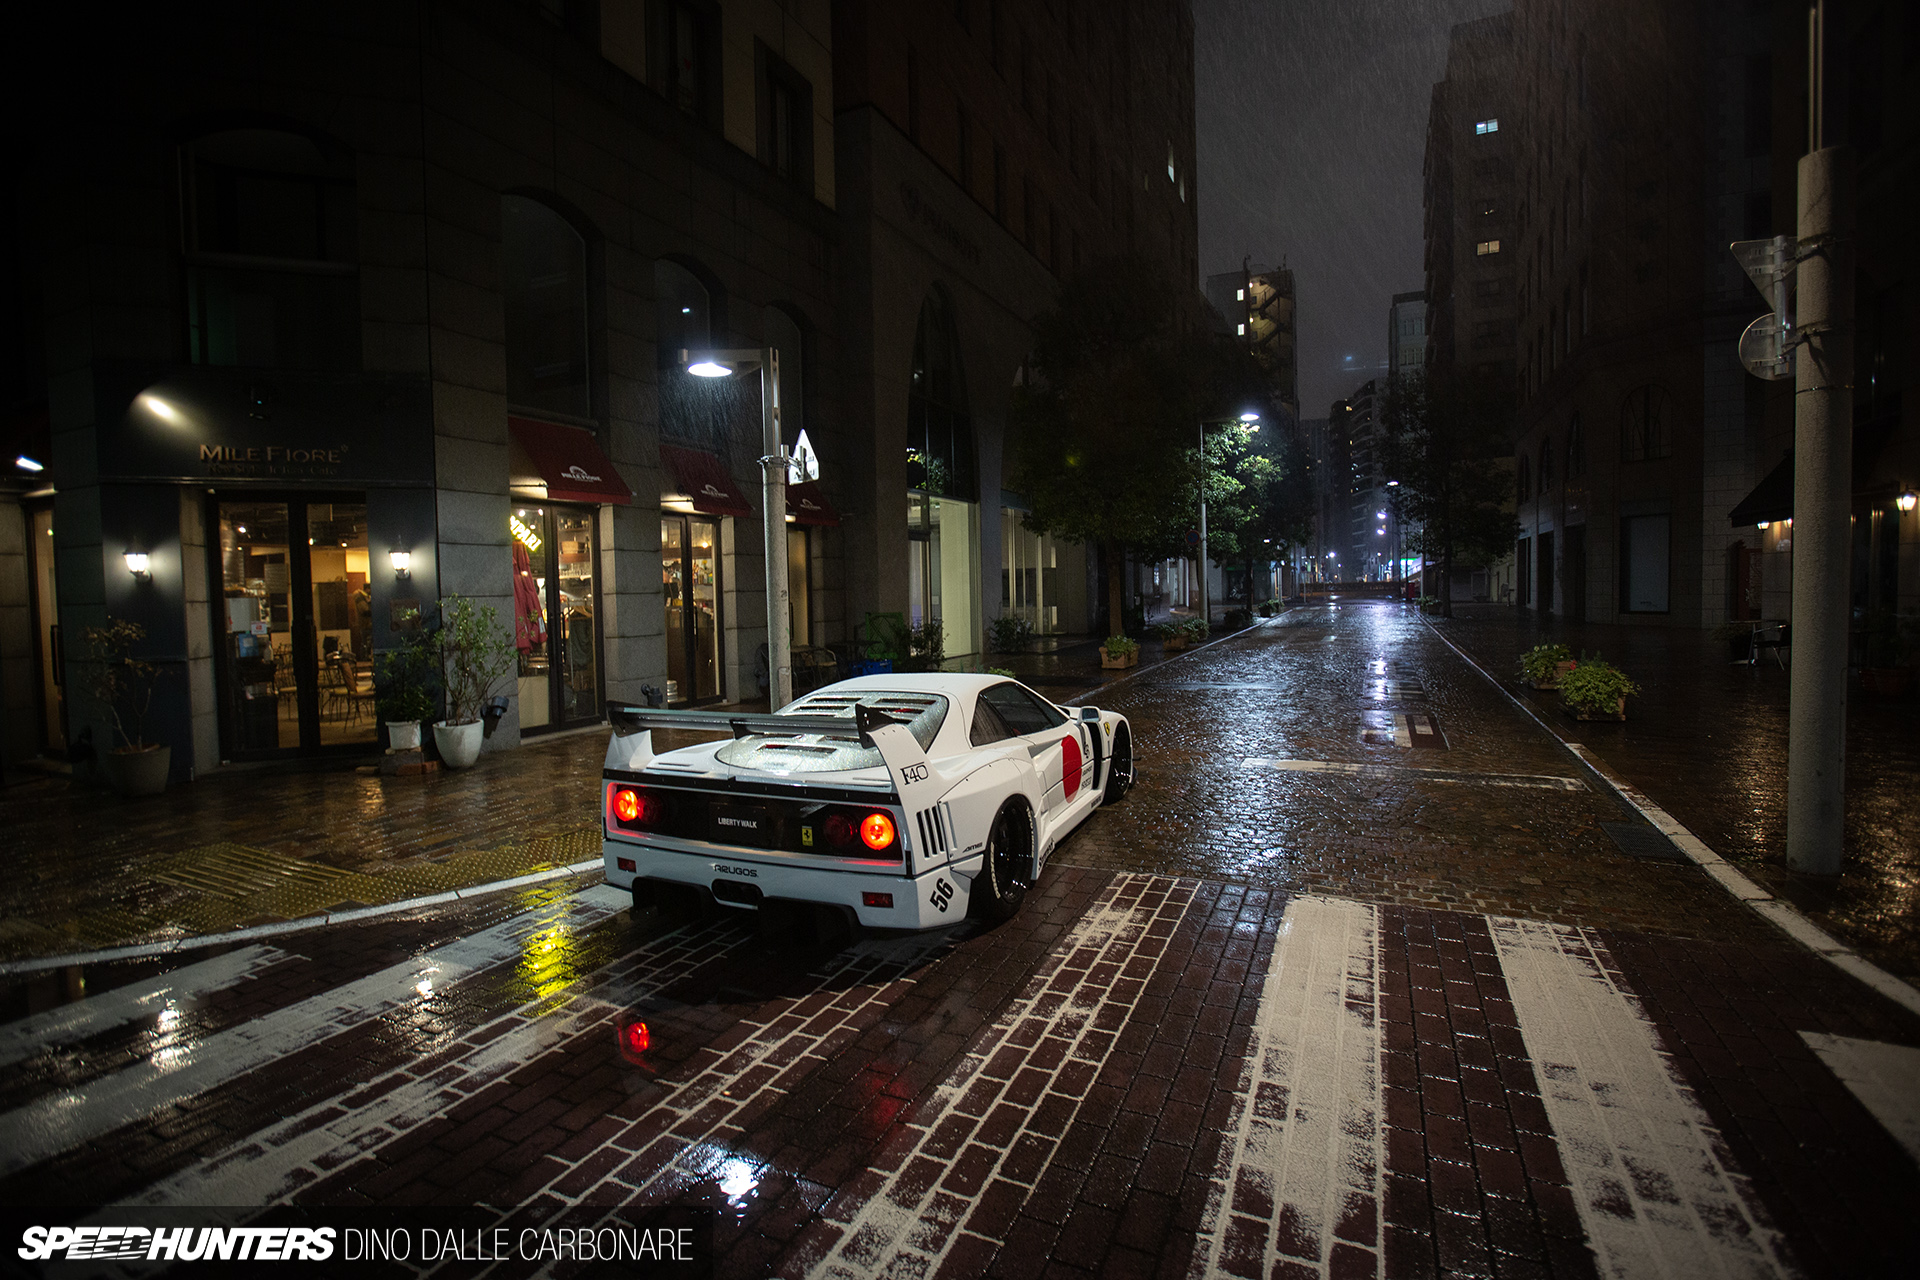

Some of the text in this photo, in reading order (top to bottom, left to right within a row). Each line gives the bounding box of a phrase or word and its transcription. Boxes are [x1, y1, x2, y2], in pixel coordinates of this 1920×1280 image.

[200, 444, 341, 465] MILE FIORE
[900, 761, 929, 785] F40
[717, 817, 758, 829] LIBERTY WALK
[929, 878, 955, 913] 56
